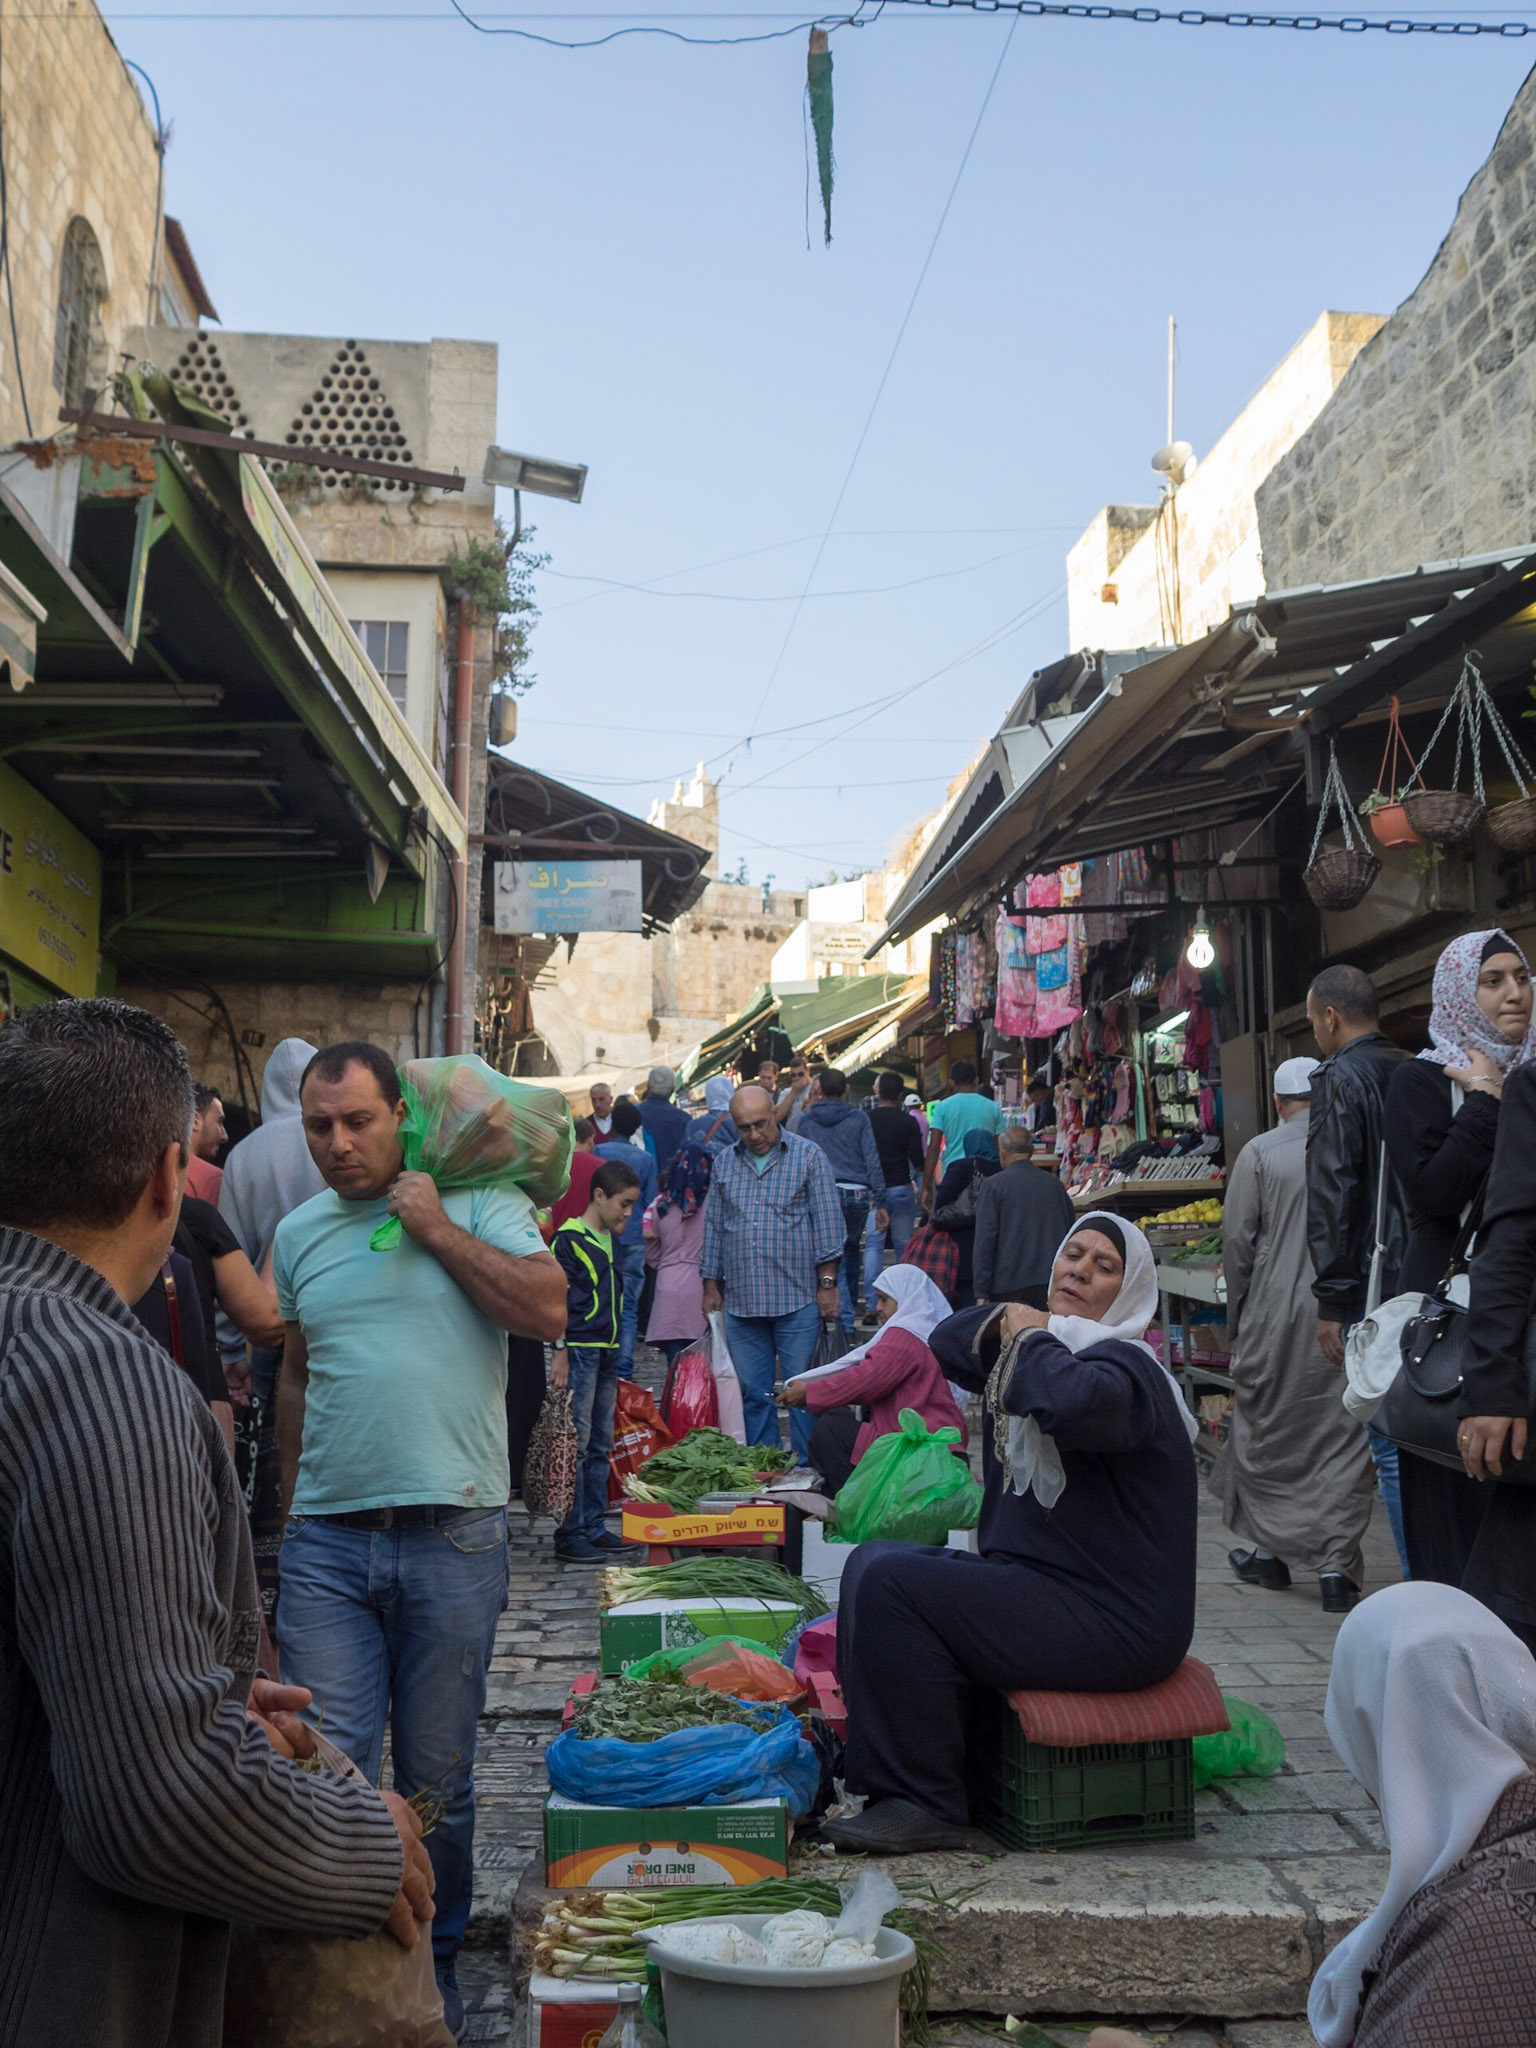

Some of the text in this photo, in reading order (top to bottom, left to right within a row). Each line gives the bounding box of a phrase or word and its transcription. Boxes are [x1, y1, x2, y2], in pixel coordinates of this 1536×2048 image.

[527, 865, 609, 895] صراف
[672, 1524, 709, 1538] הדרים
[715, 1519, 747, 1533] שיווק
[665, 1863, 695, 1874] BNEI
